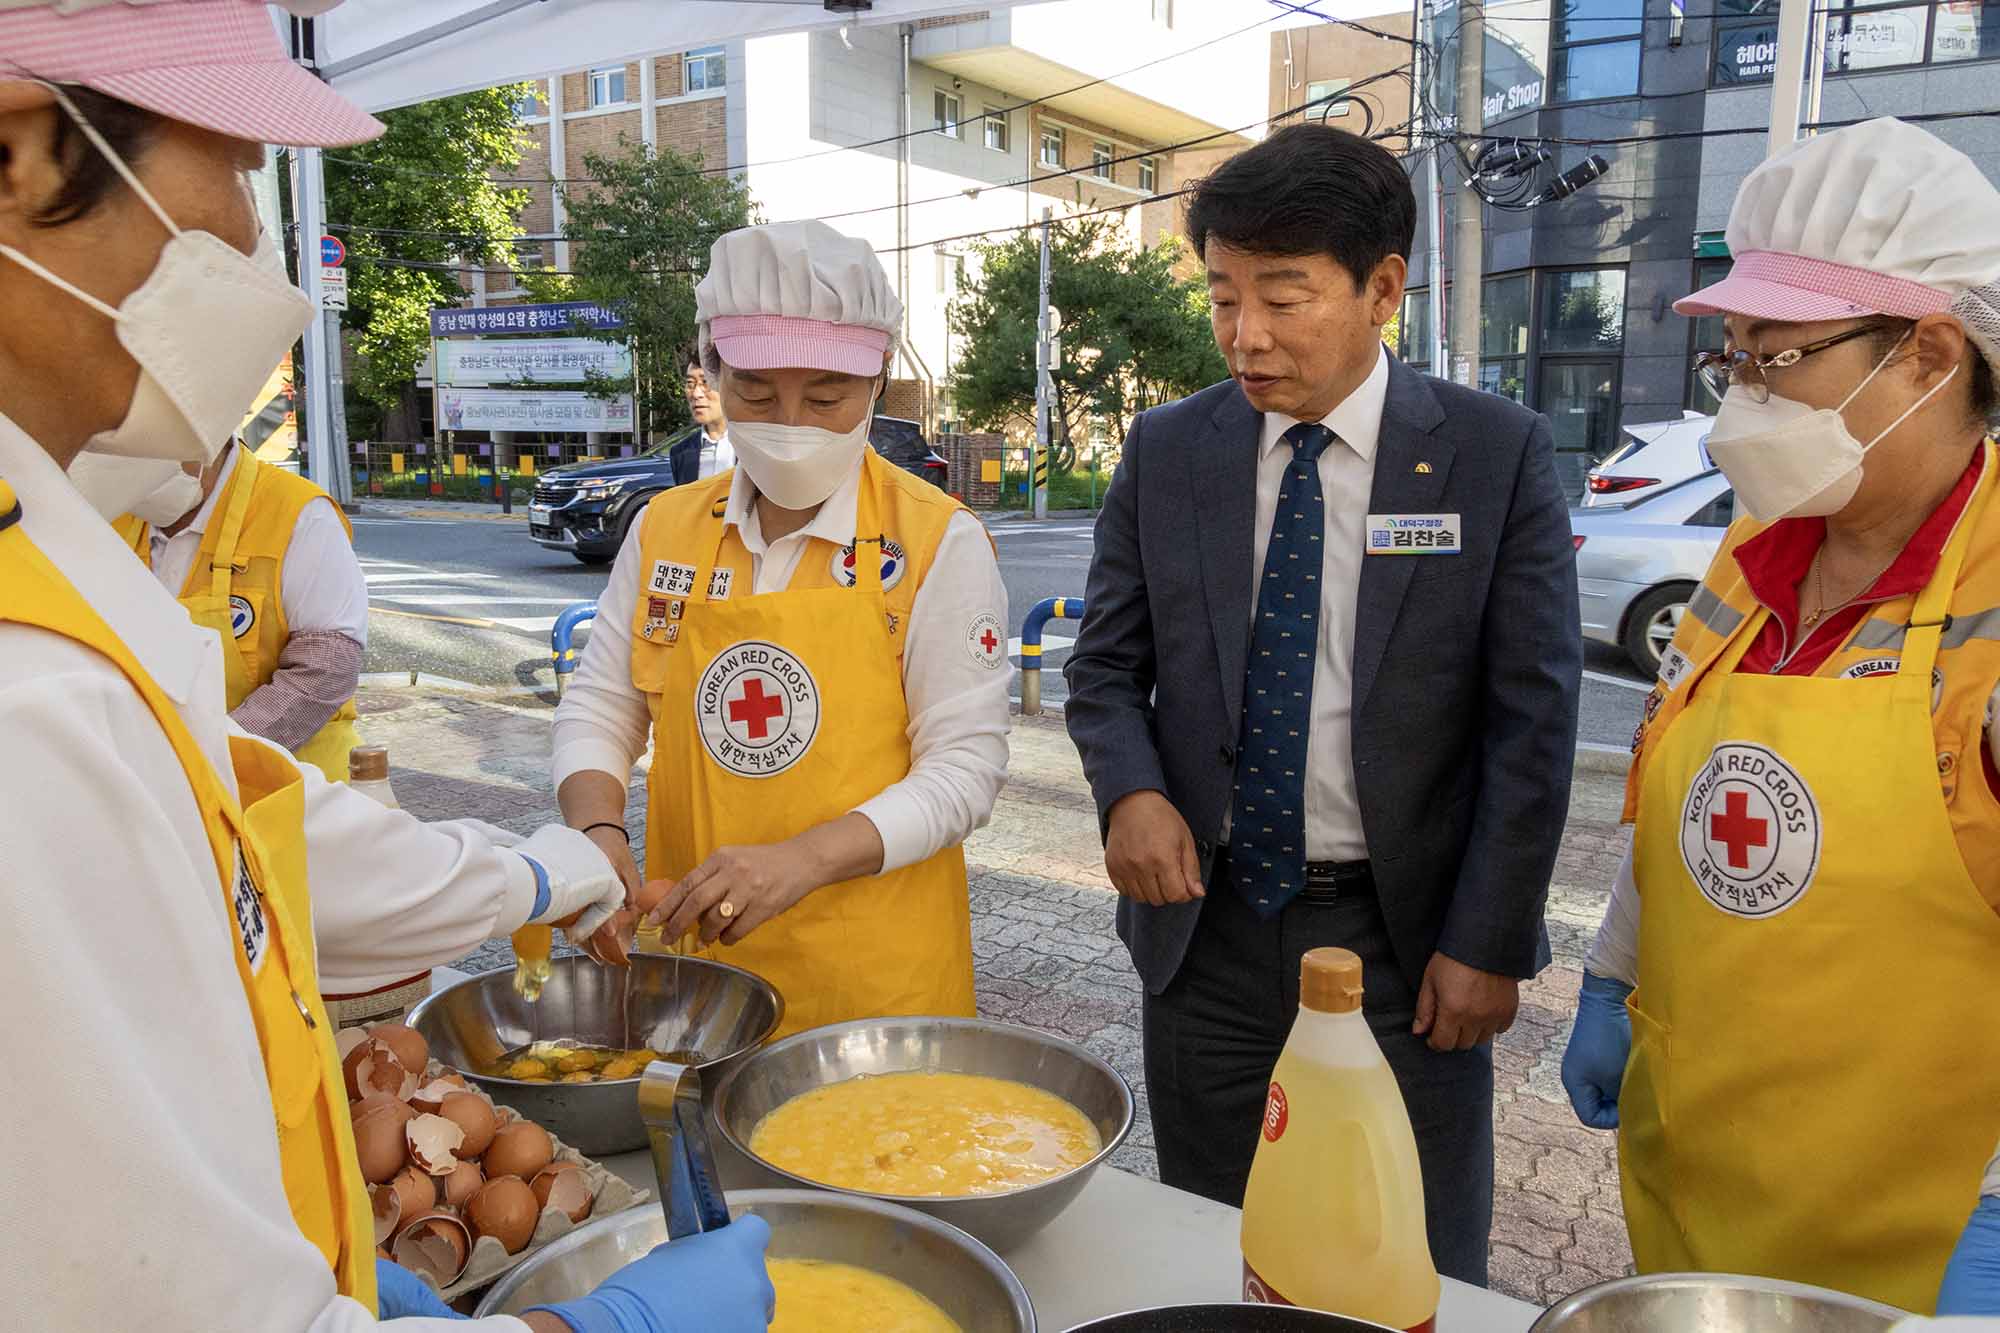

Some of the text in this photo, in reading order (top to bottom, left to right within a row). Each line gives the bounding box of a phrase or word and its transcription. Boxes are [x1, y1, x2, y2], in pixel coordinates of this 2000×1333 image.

[1736, 42, 1778, 64] 헤어
[1739, 65, 1760, 76] HAIR
[1483, 81, 1540, 118] Hair Shop
[438, 314, 457, 331] 충남
[458, 312, 476, 329] 인재
[478, 312, 506, 328] 양성의
[507, 311, 526, 327] 요람
[529, 310, 568, 328] 충청남도
[1399, 519, 1443, 528] 대덕구청장
[1393, 529, 1455, 547] 김찬술
[1848, 661, 1893, 679] KOREAN
[703, 650, 809, 715] KOREAN RED CROSS
[719, 732, 803, 769] 대한적십자사
[1690, 755, 1807, 834] KOREAN RED CROSS
[1698, 858, 1795, 908] 대한적십자사
